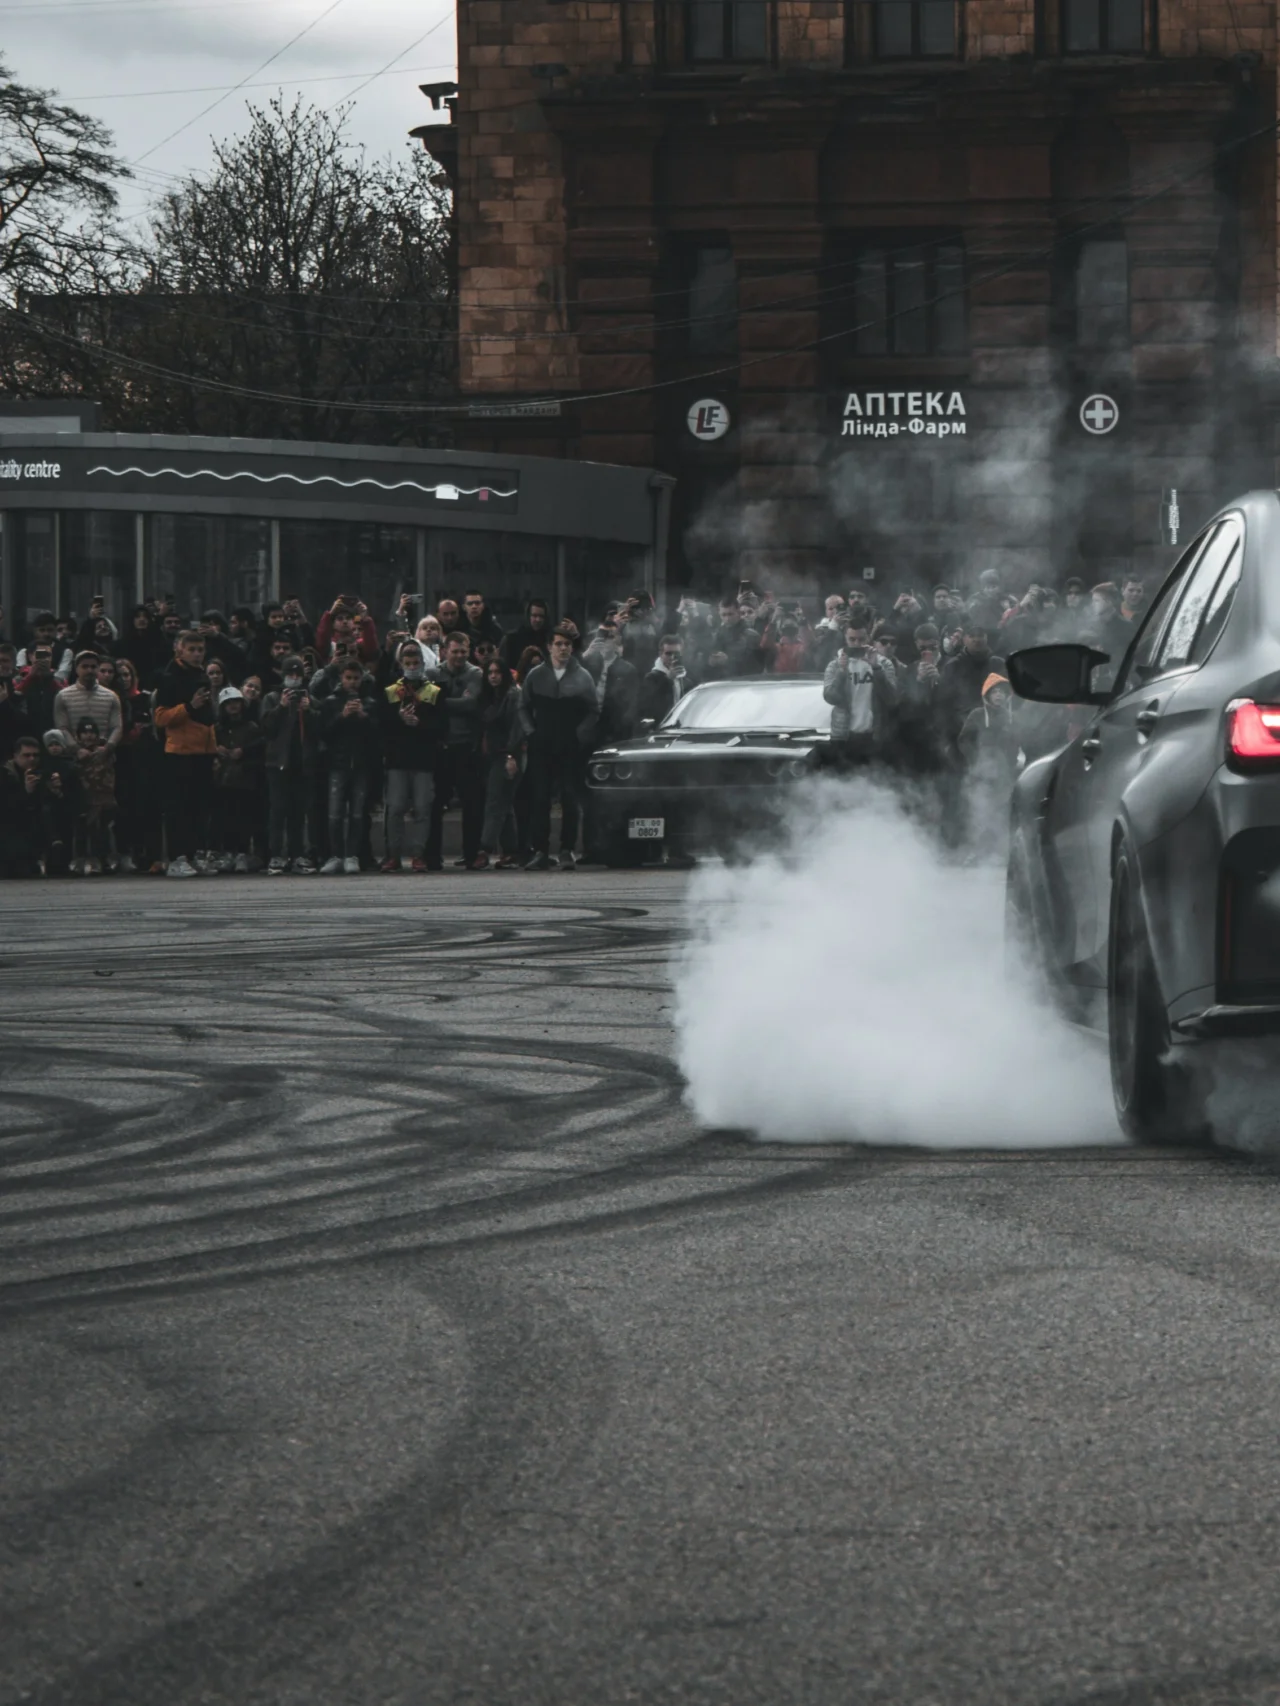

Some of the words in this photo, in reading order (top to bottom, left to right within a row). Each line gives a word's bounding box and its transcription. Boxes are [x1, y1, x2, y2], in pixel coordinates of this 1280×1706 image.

[843, 392, 966, 416] АПТЕКА
[696, 406, 721, 434] LF
[841, 417, 967, 438] Лінда-Фарм
[24, 460, 61, 478] centre
